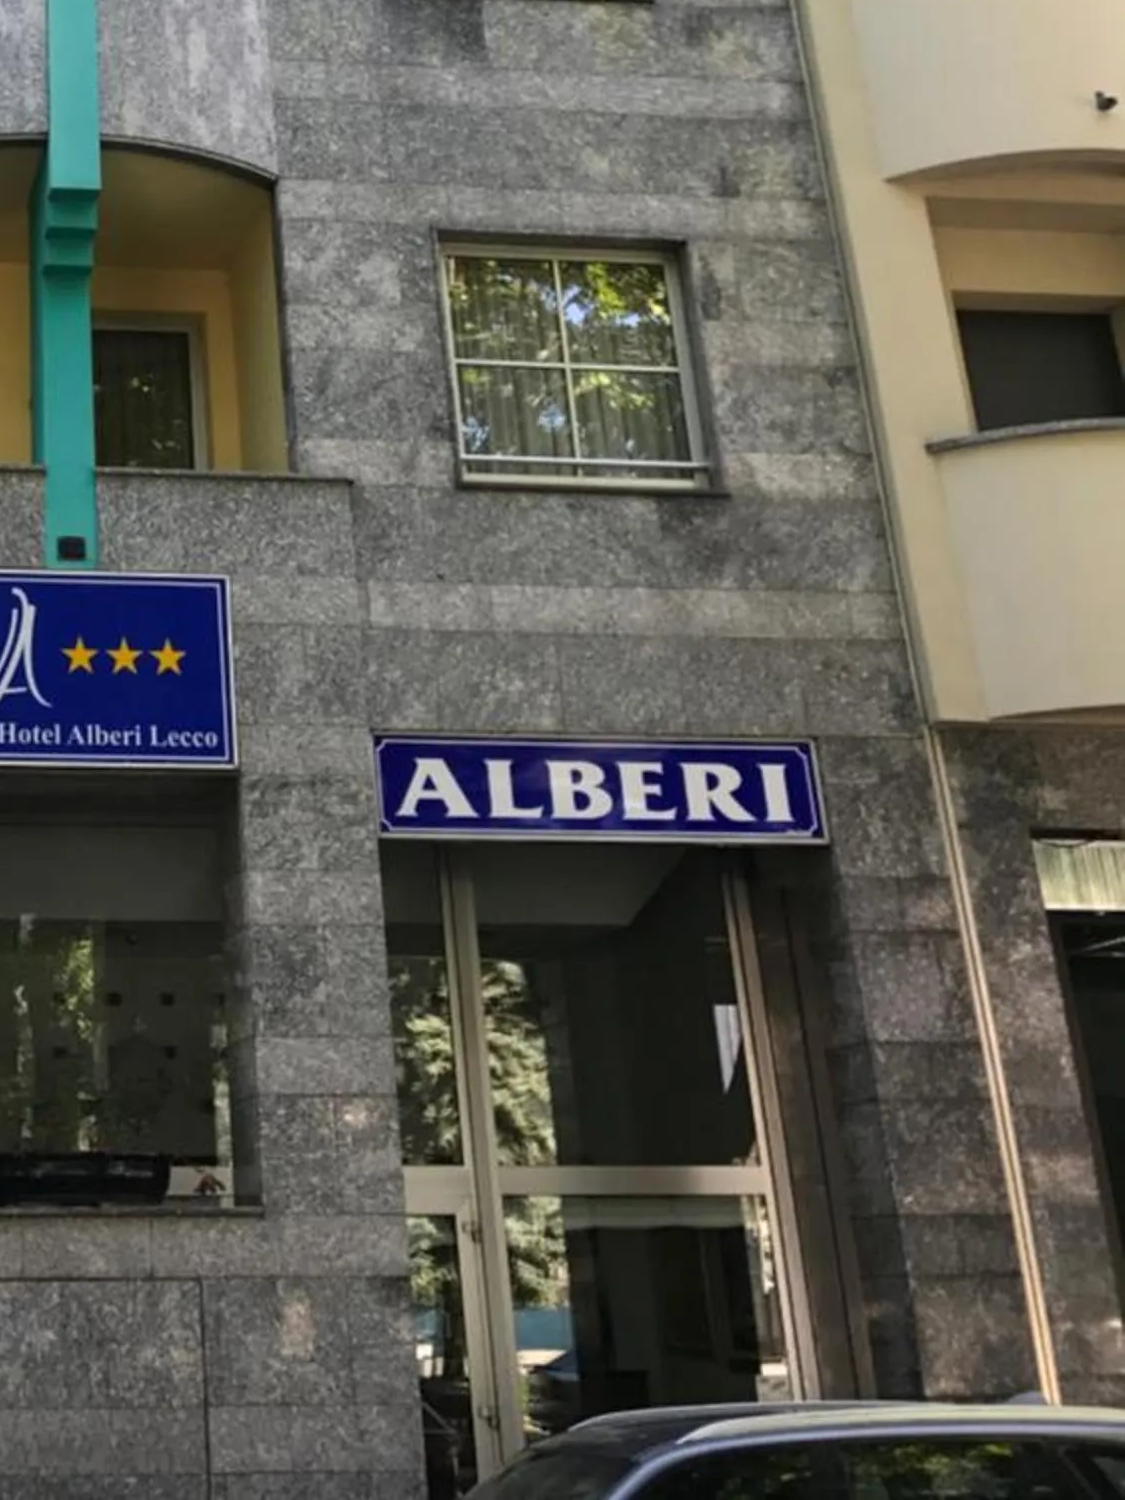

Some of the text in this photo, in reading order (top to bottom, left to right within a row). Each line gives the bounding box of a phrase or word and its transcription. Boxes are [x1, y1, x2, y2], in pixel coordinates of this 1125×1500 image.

[67, 723, 141, 748] Alberi
[150, 725, 218, 748] Lecco
[396, 757, 795, 822] ALBERI
